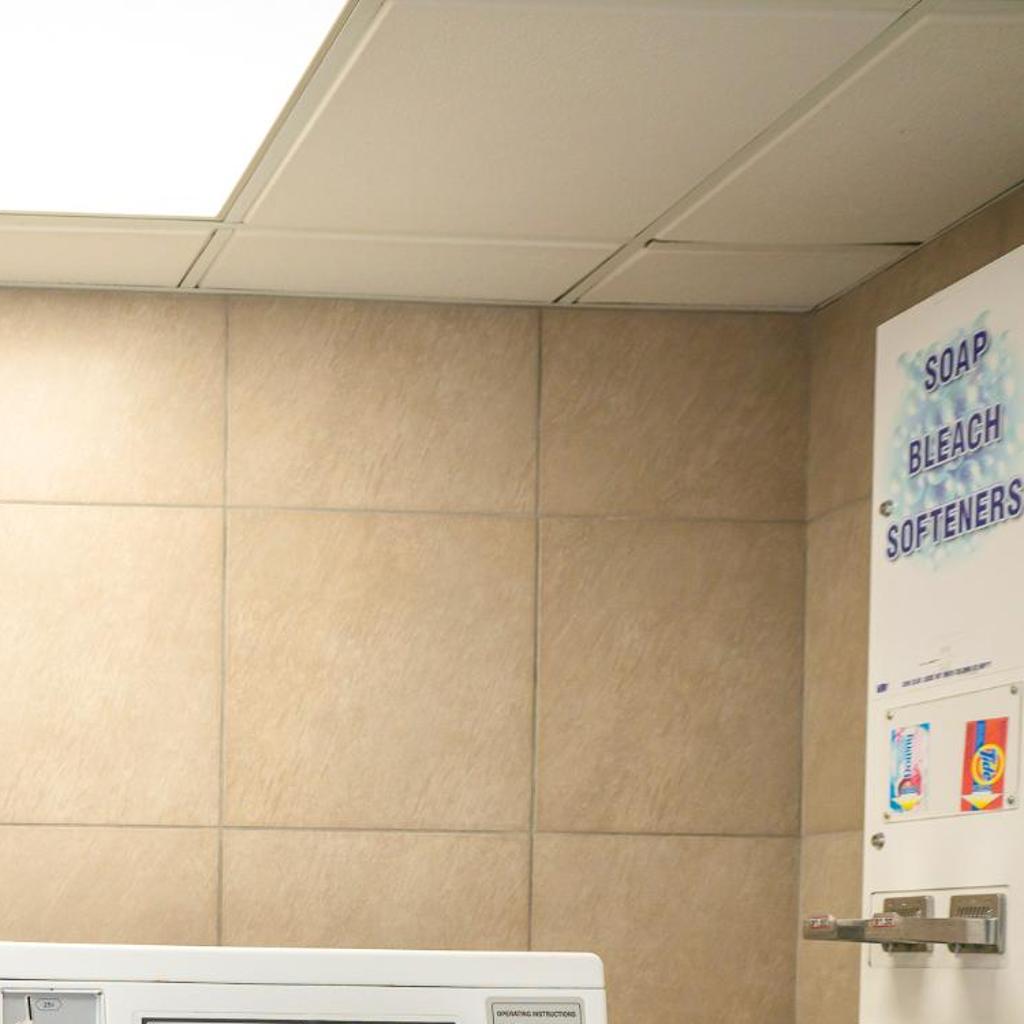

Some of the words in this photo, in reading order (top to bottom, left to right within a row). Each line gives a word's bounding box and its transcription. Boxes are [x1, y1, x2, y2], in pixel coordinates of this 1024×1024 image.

[925, 330, 989, 391] SOAP
[908, 404, 1001, 476] BLEACH
[887, 478, 1023, 559] SOFTENERS
[532, 1010, 577, 1018] INSTRUCTIONS
